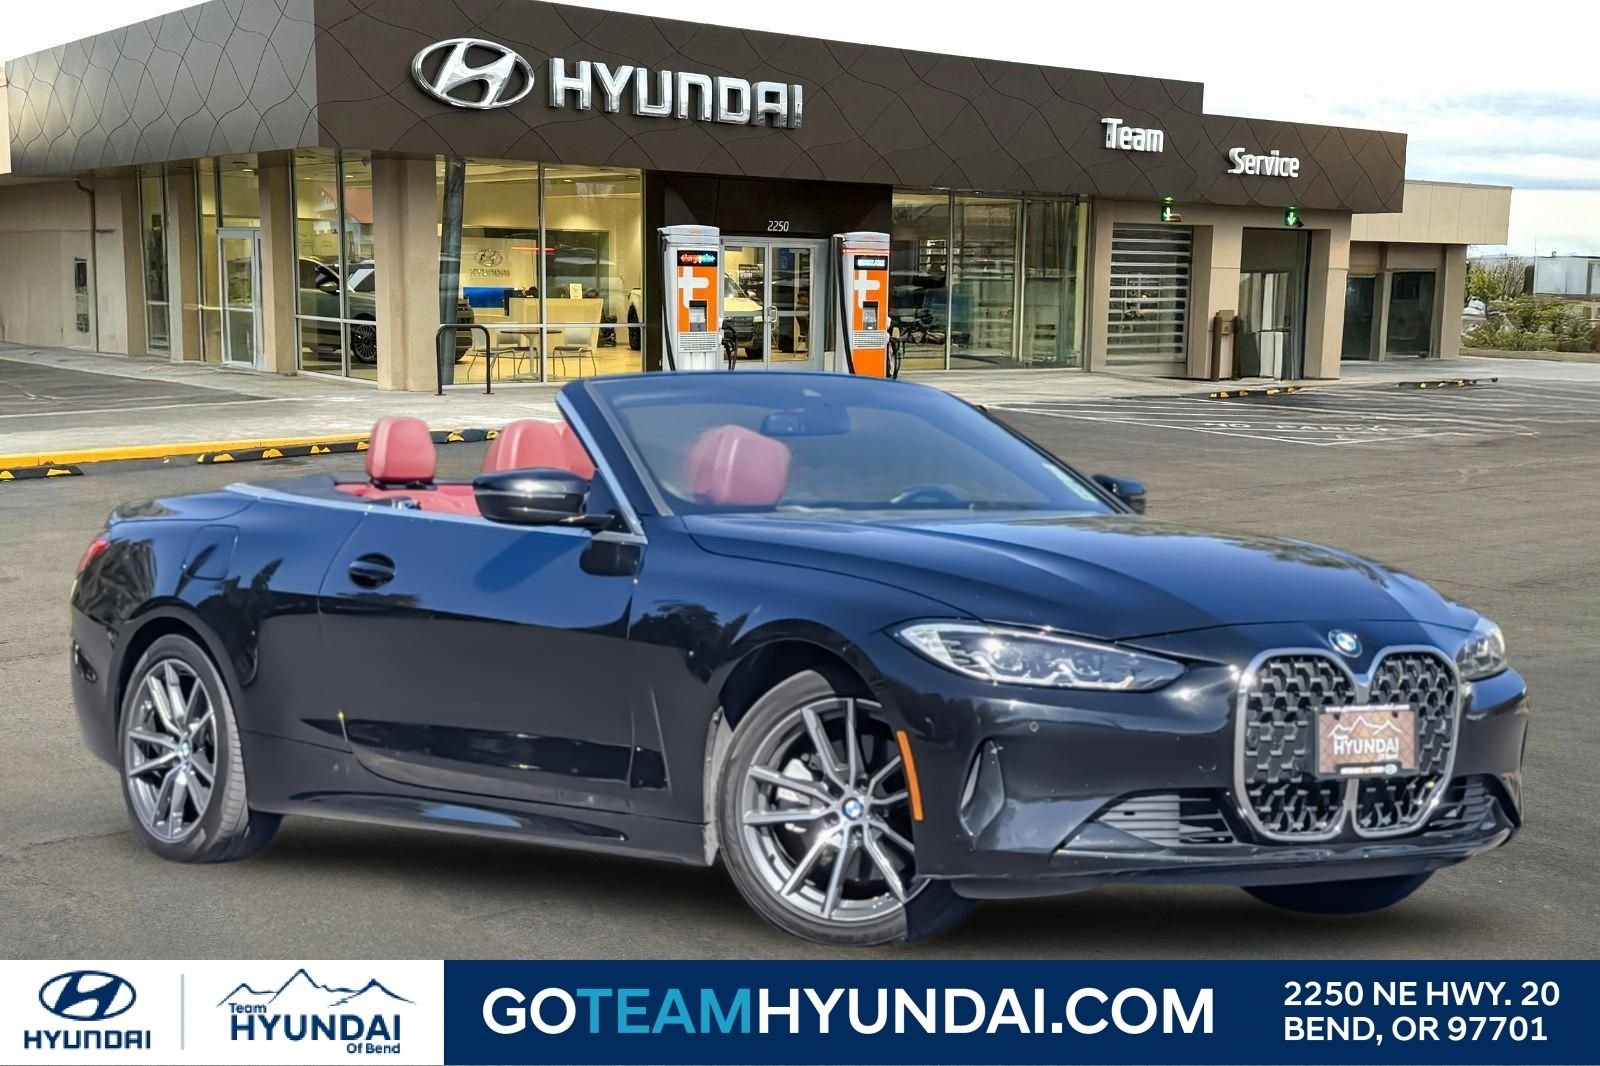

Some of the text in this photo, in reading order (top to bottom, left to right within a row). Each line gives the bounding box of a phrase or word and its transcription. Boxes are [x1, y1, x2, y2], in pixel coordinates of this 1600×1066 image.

[549, 57, 803, 128] HYUNDAI
[1101, 117, 1164, 152] Team
[1227, 147, 1300, 178] Service
[767, 220, 790, 232] 2250
[1333, 737, 1399, 755] HYUNDAI
